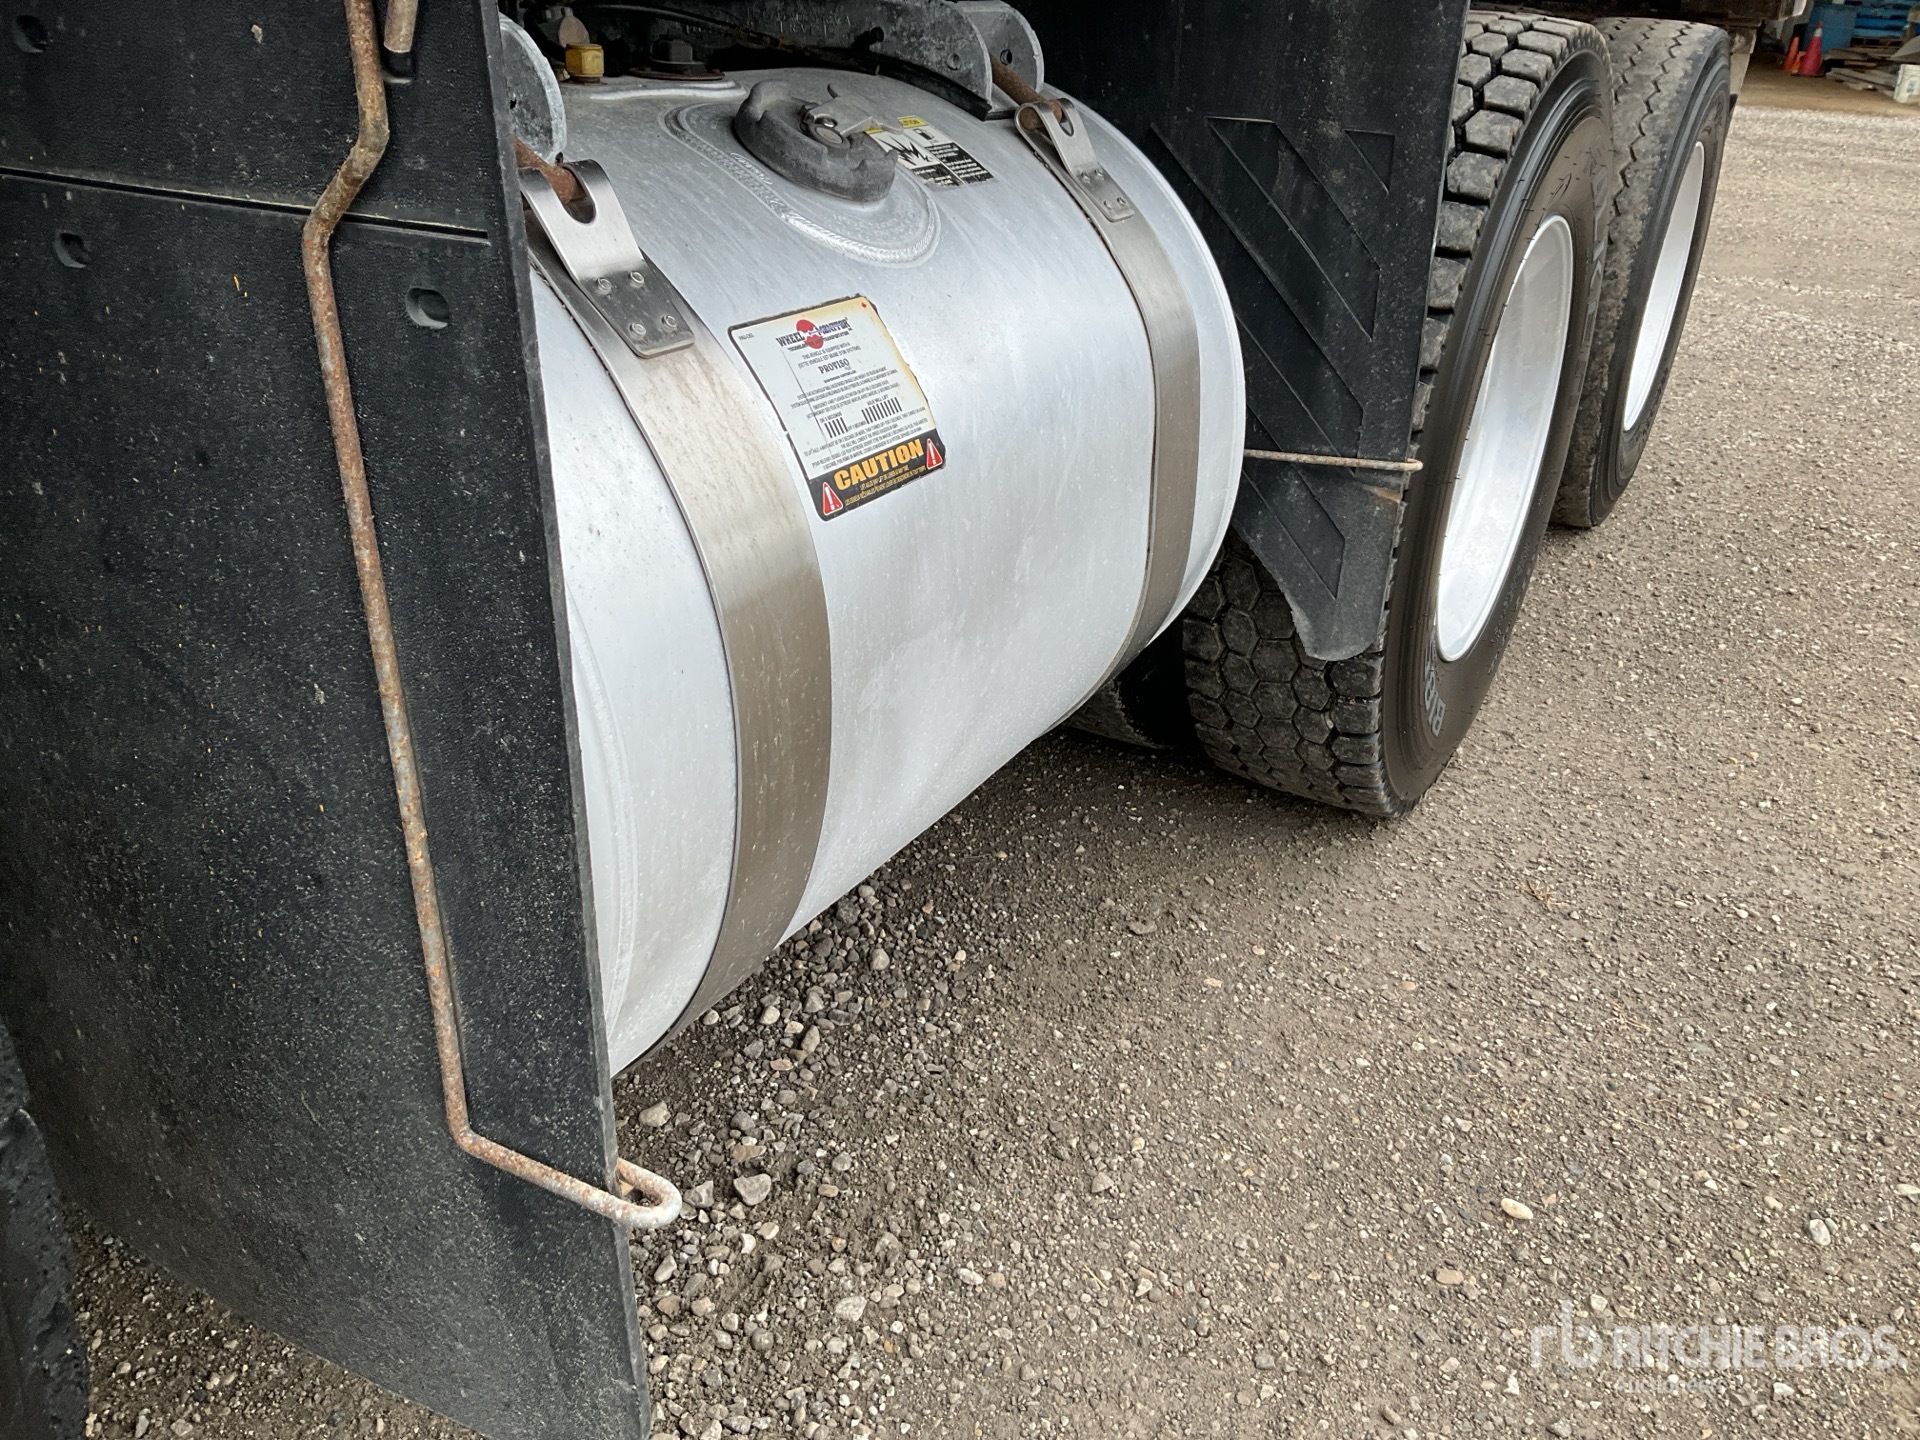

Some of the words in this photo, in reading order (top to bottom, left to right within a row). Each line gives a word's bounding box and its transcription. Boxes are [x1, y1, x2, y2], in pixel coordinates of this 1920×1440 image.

[776, 331, 805, 347] WHEEL
[818, 358, 850, 374] PROVISO
[833, 438, 924, 491] CAUTION
